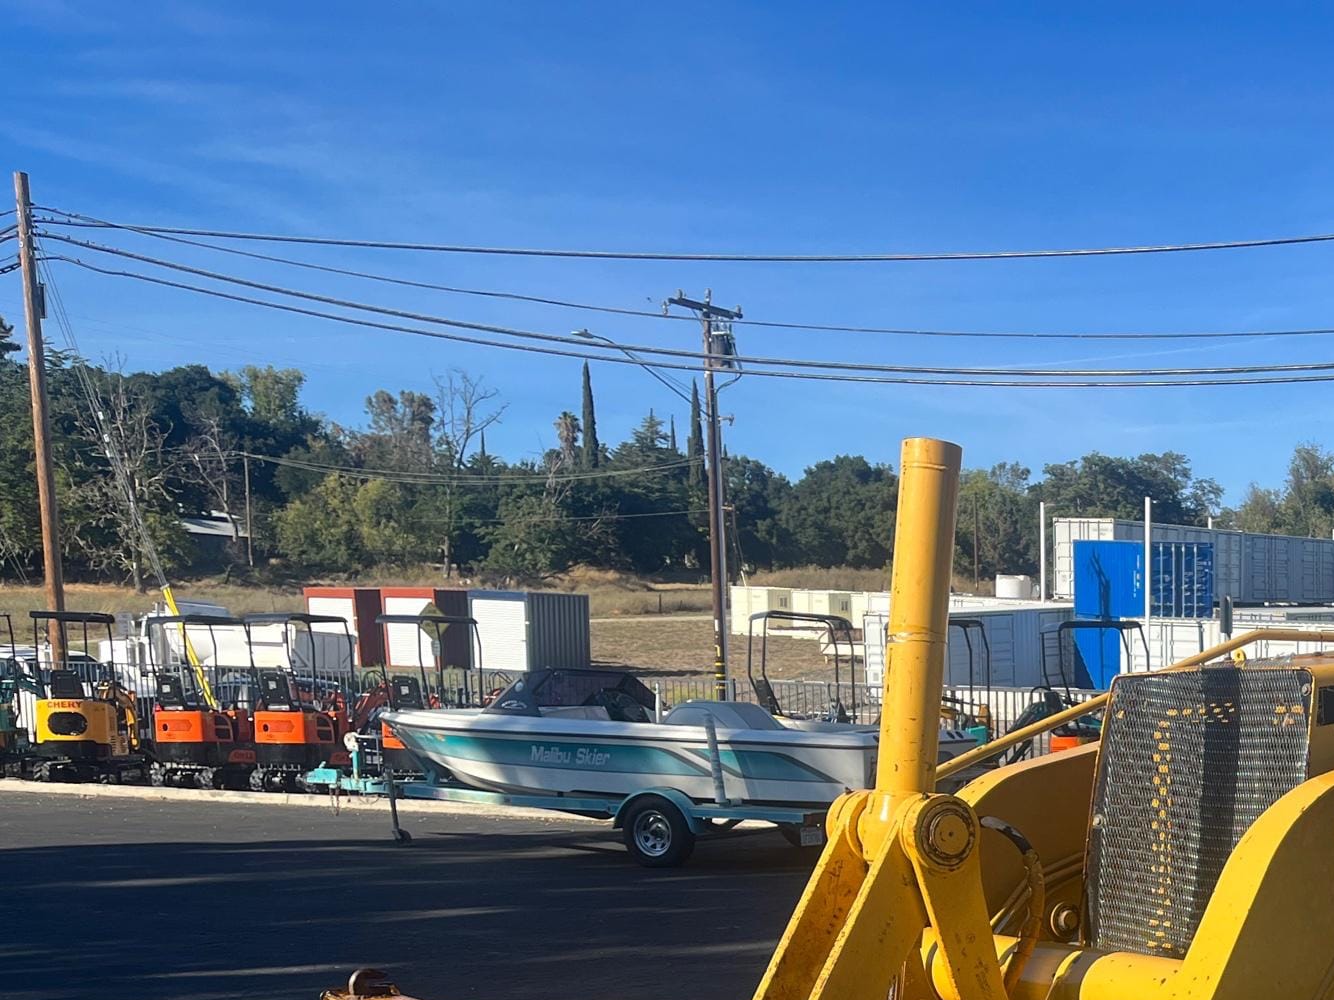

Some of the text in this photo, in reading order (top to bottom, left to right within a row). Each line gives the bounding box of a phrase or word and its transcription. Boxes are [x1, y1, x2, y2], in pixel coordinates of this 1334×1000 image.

[47, 701, 82, 709] CHERY
[531, 745, 611, 766] Malibu Skier
